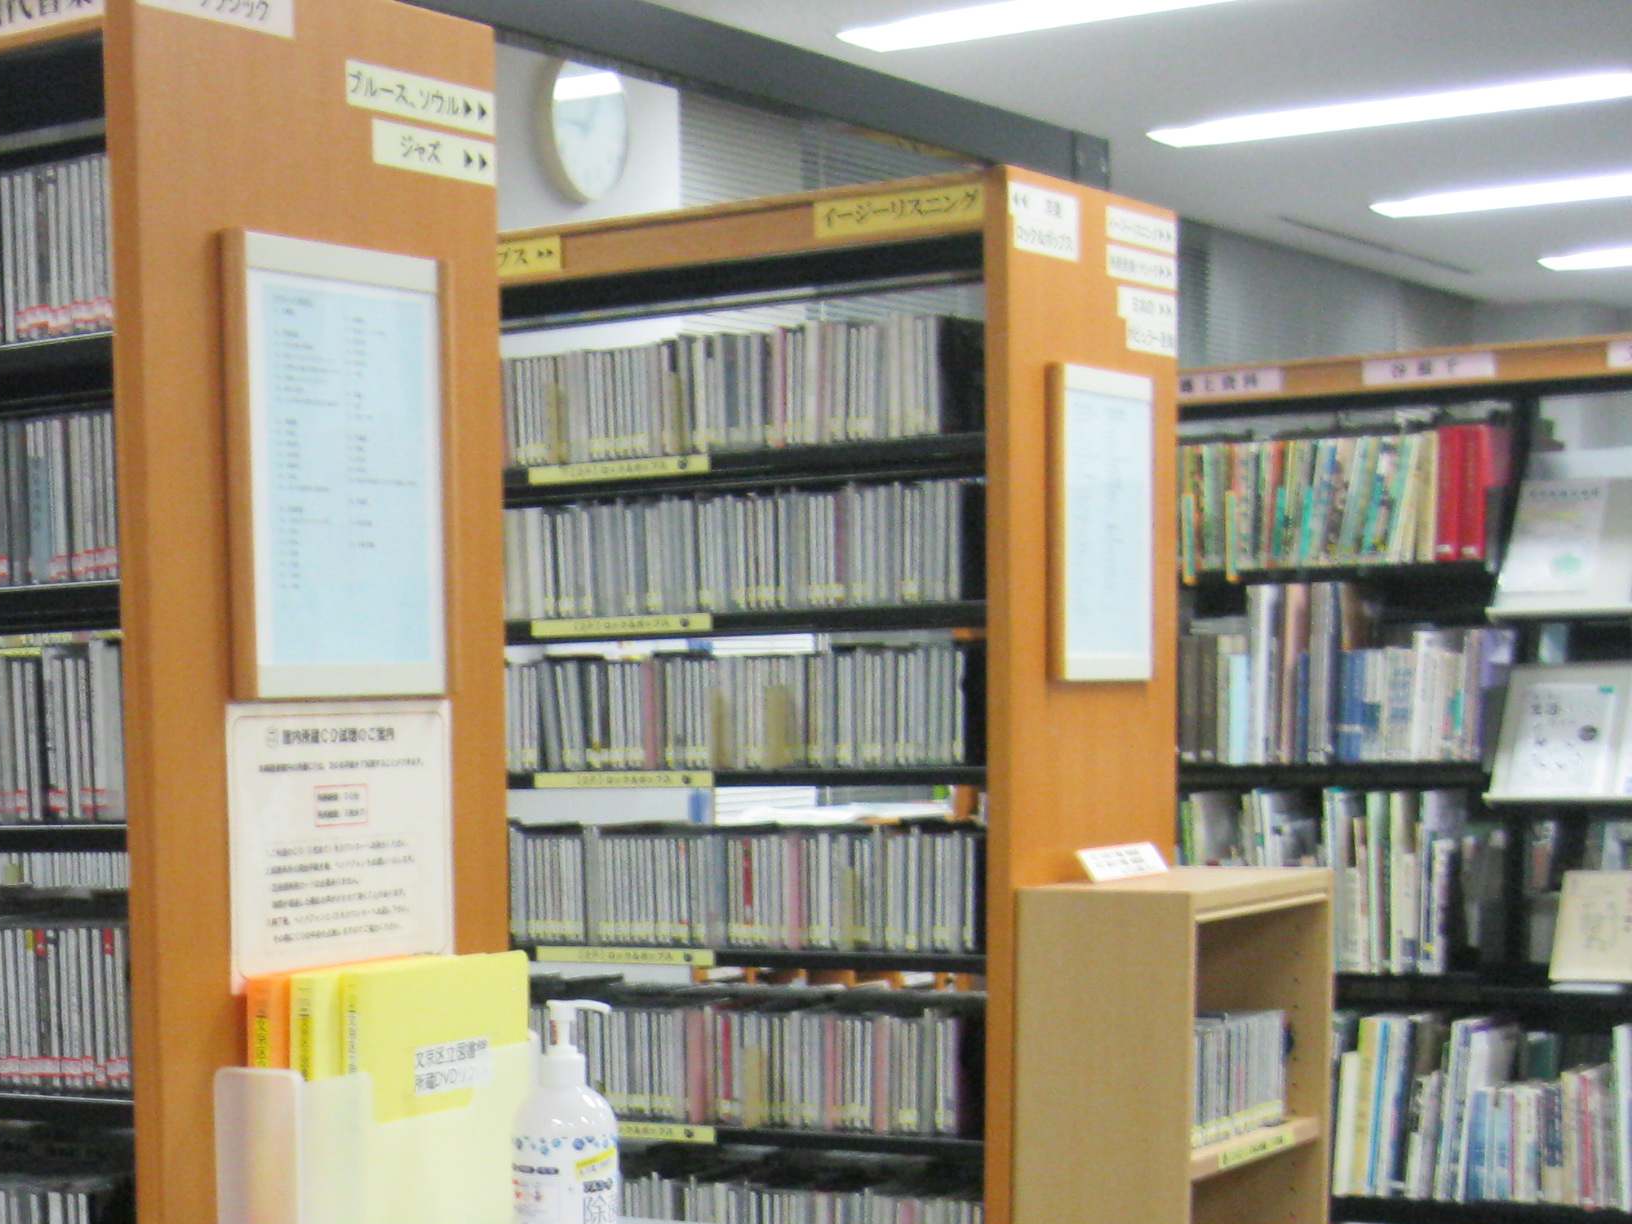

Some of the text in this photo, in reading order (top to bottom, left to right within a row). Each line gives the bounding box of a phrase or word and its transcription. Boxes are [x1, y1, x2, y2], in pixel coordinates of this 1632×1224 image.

[400, 135, 442, 164] ジャズ
[824, 189, 979, 227] イージーリスニング
